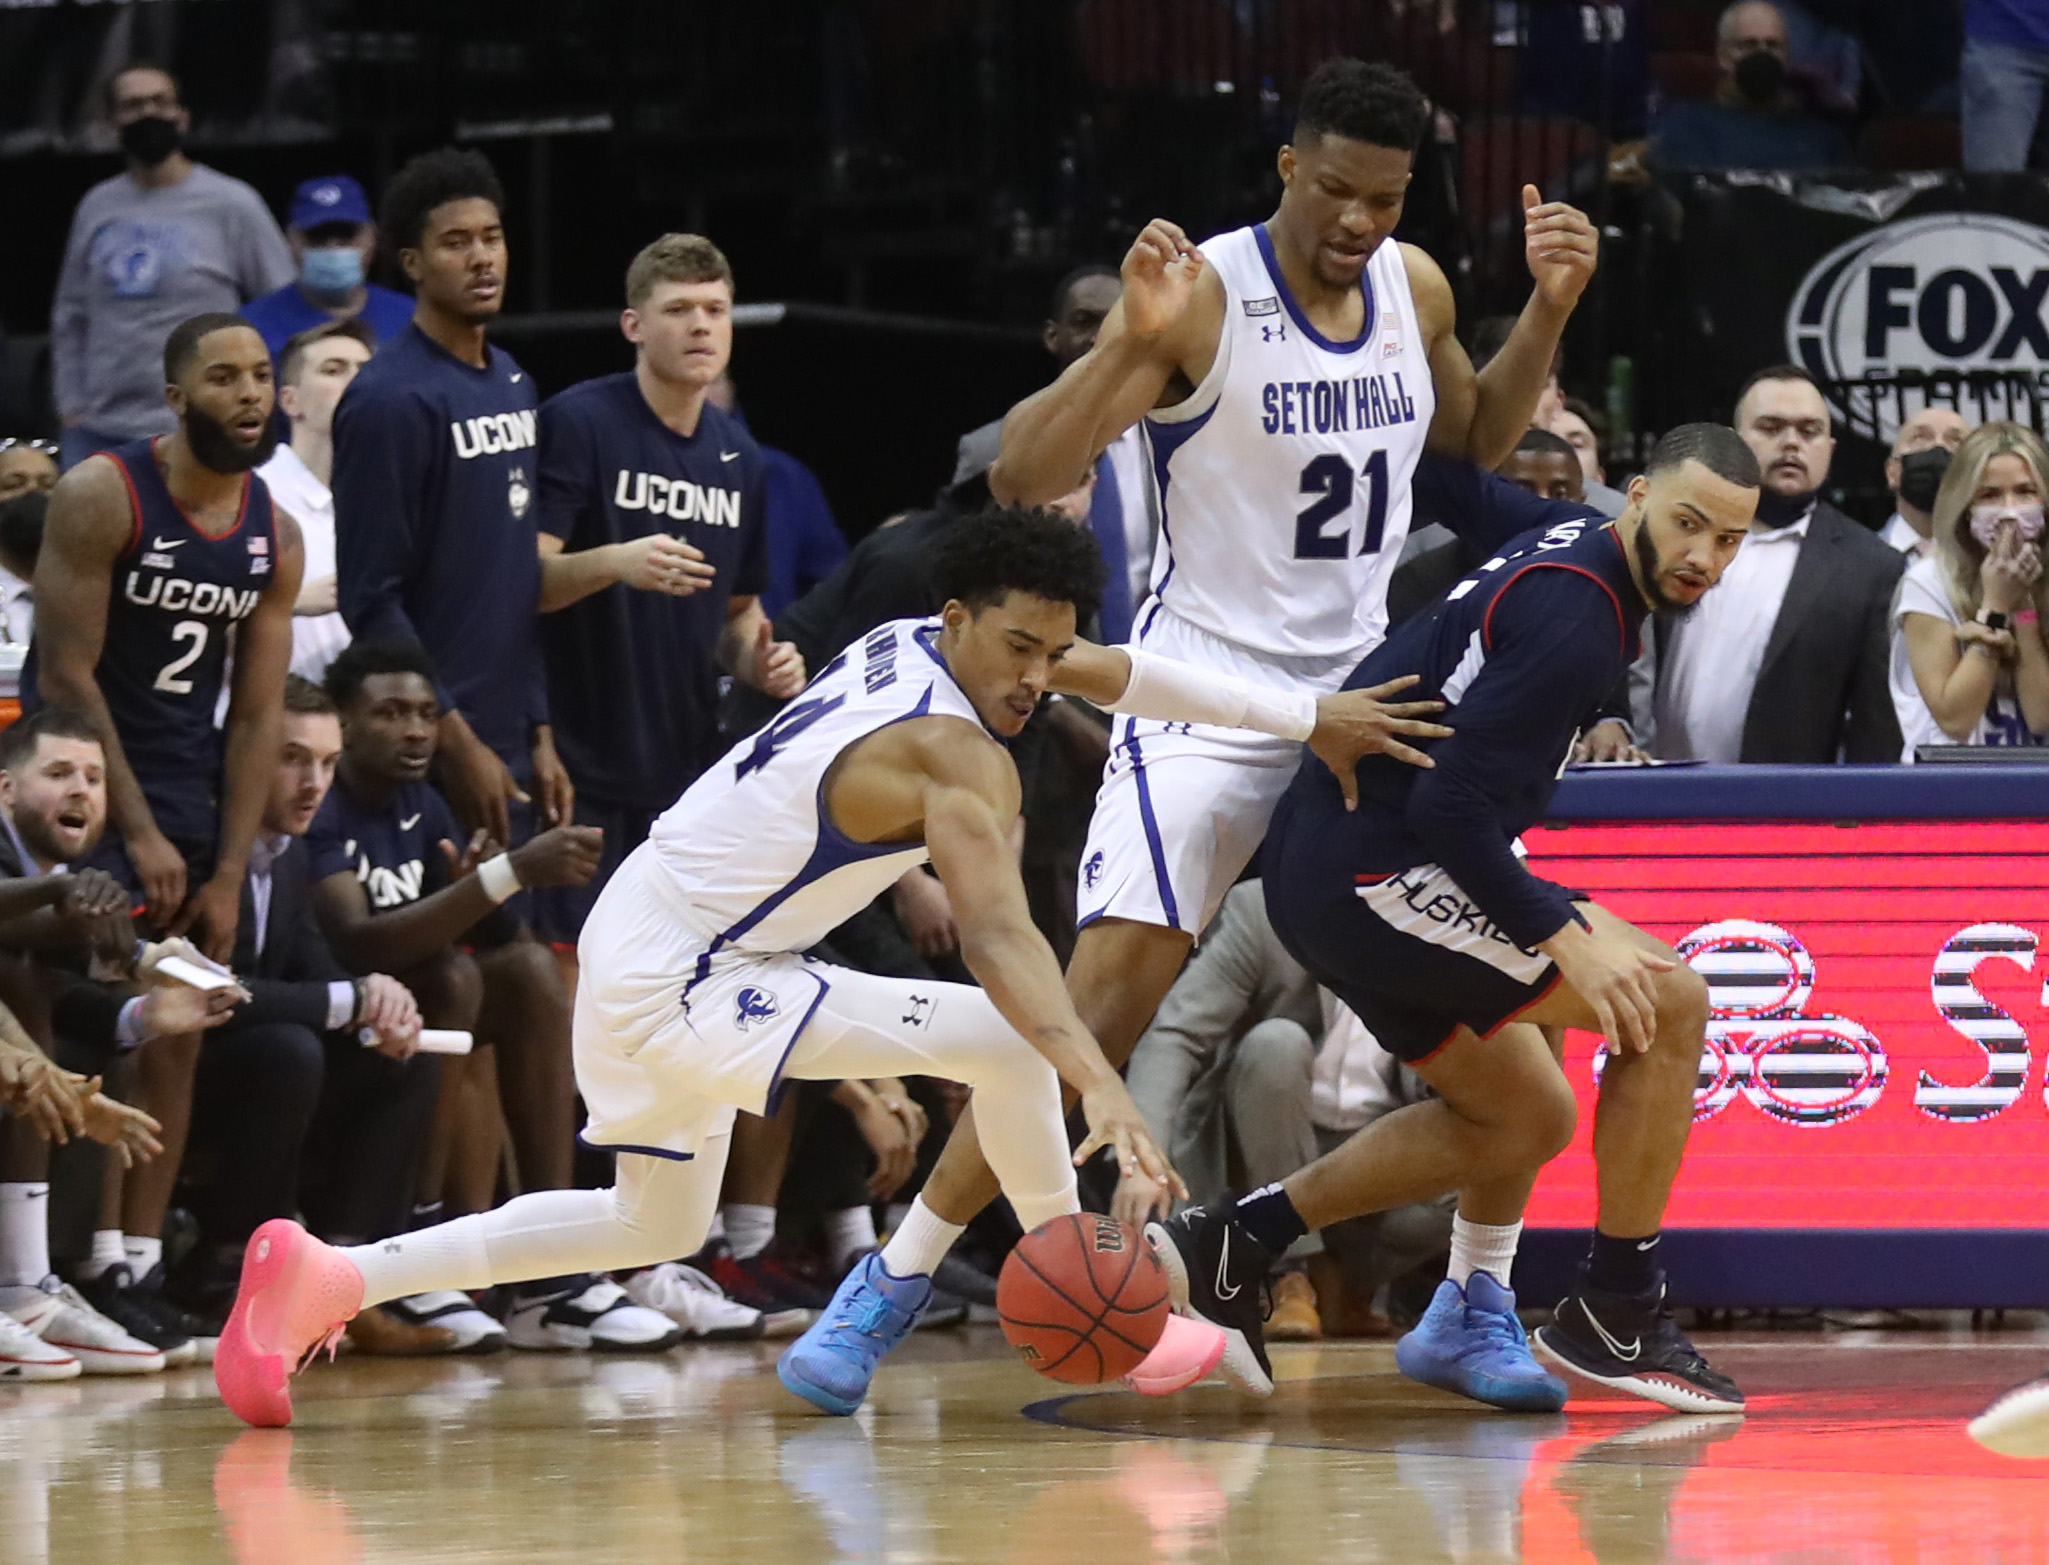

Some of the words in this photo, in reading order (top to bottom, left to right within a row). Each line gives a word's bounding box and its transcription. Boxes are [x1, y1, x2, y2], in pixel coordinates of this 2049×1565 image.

[1865, 265, 2049, 360] FOX
[451, 409, 537, 459] UCON
[1261, 381, 1350, 435] SETON
[1352, 372, 1416, 430] HALL
[614, 469, 741, 528] UCONN
[1294, 449, 1388, 560] 21
[154, 620, 209, 694] 2
